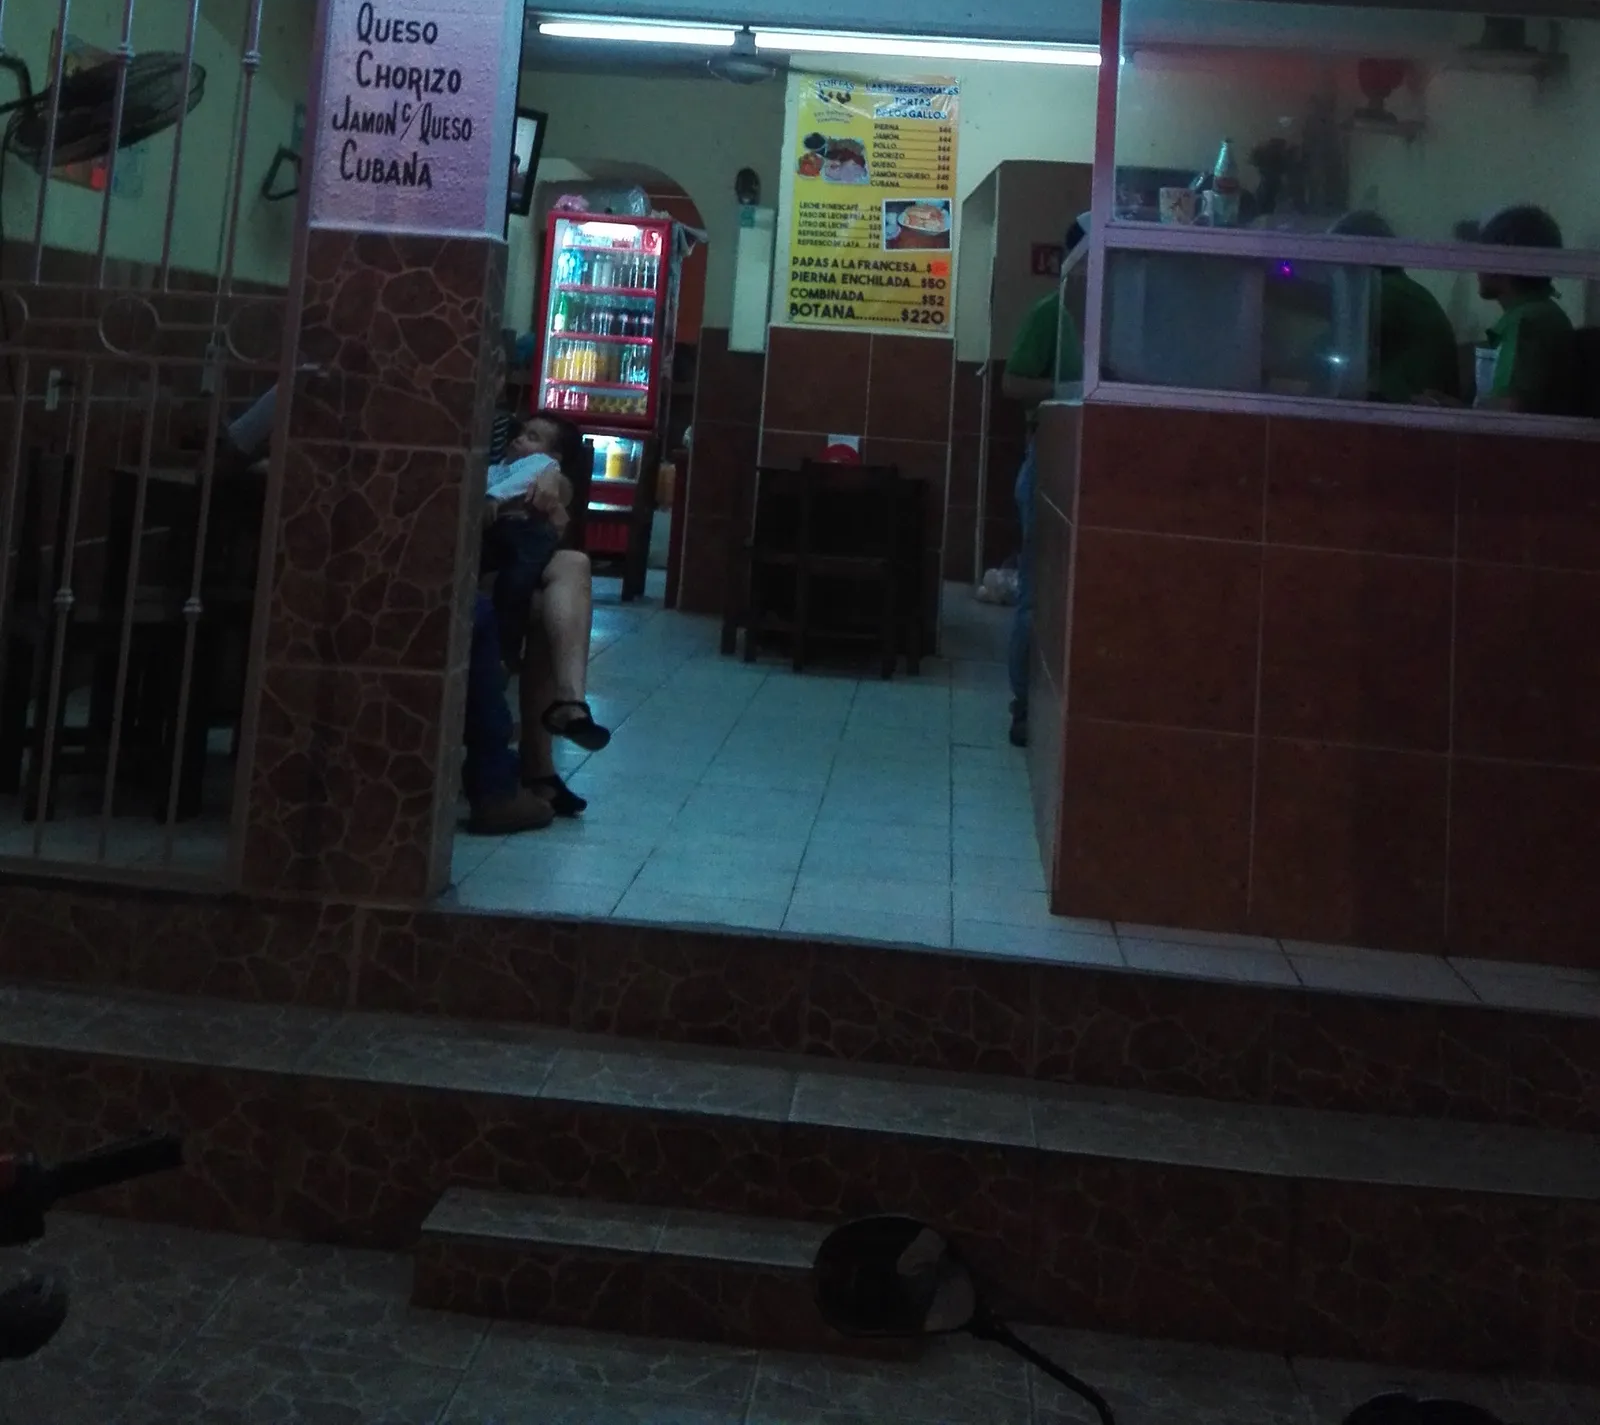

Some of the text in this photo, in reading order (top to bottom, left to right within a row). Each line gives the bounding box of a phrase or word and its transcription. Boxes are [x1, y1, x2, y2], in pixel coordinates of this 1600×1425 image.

[357, 2, 439, 46] QUESO
[356, 50, 462, 102] CHORIZO
[894, 96, 932, 107] TORTAS
[332, 94, 398, 136] JAMON
[908, 109, 947, 120] GALLOS
[340, 138, 433, 191] CUBANA
[792, 256, 829, 269] PAPAS
[830, 257, 839, 269] A
[841, 258, 856, 271] LA
[857, 260, 918, 273] FRANCESA
[791, 271, 837, 284] PIERNA
[841, 272, 911, 288] ENCHILADA
[789, 287, 865, 302] COMBINADA
[790, 302, 945, 325] BOTANA $220
